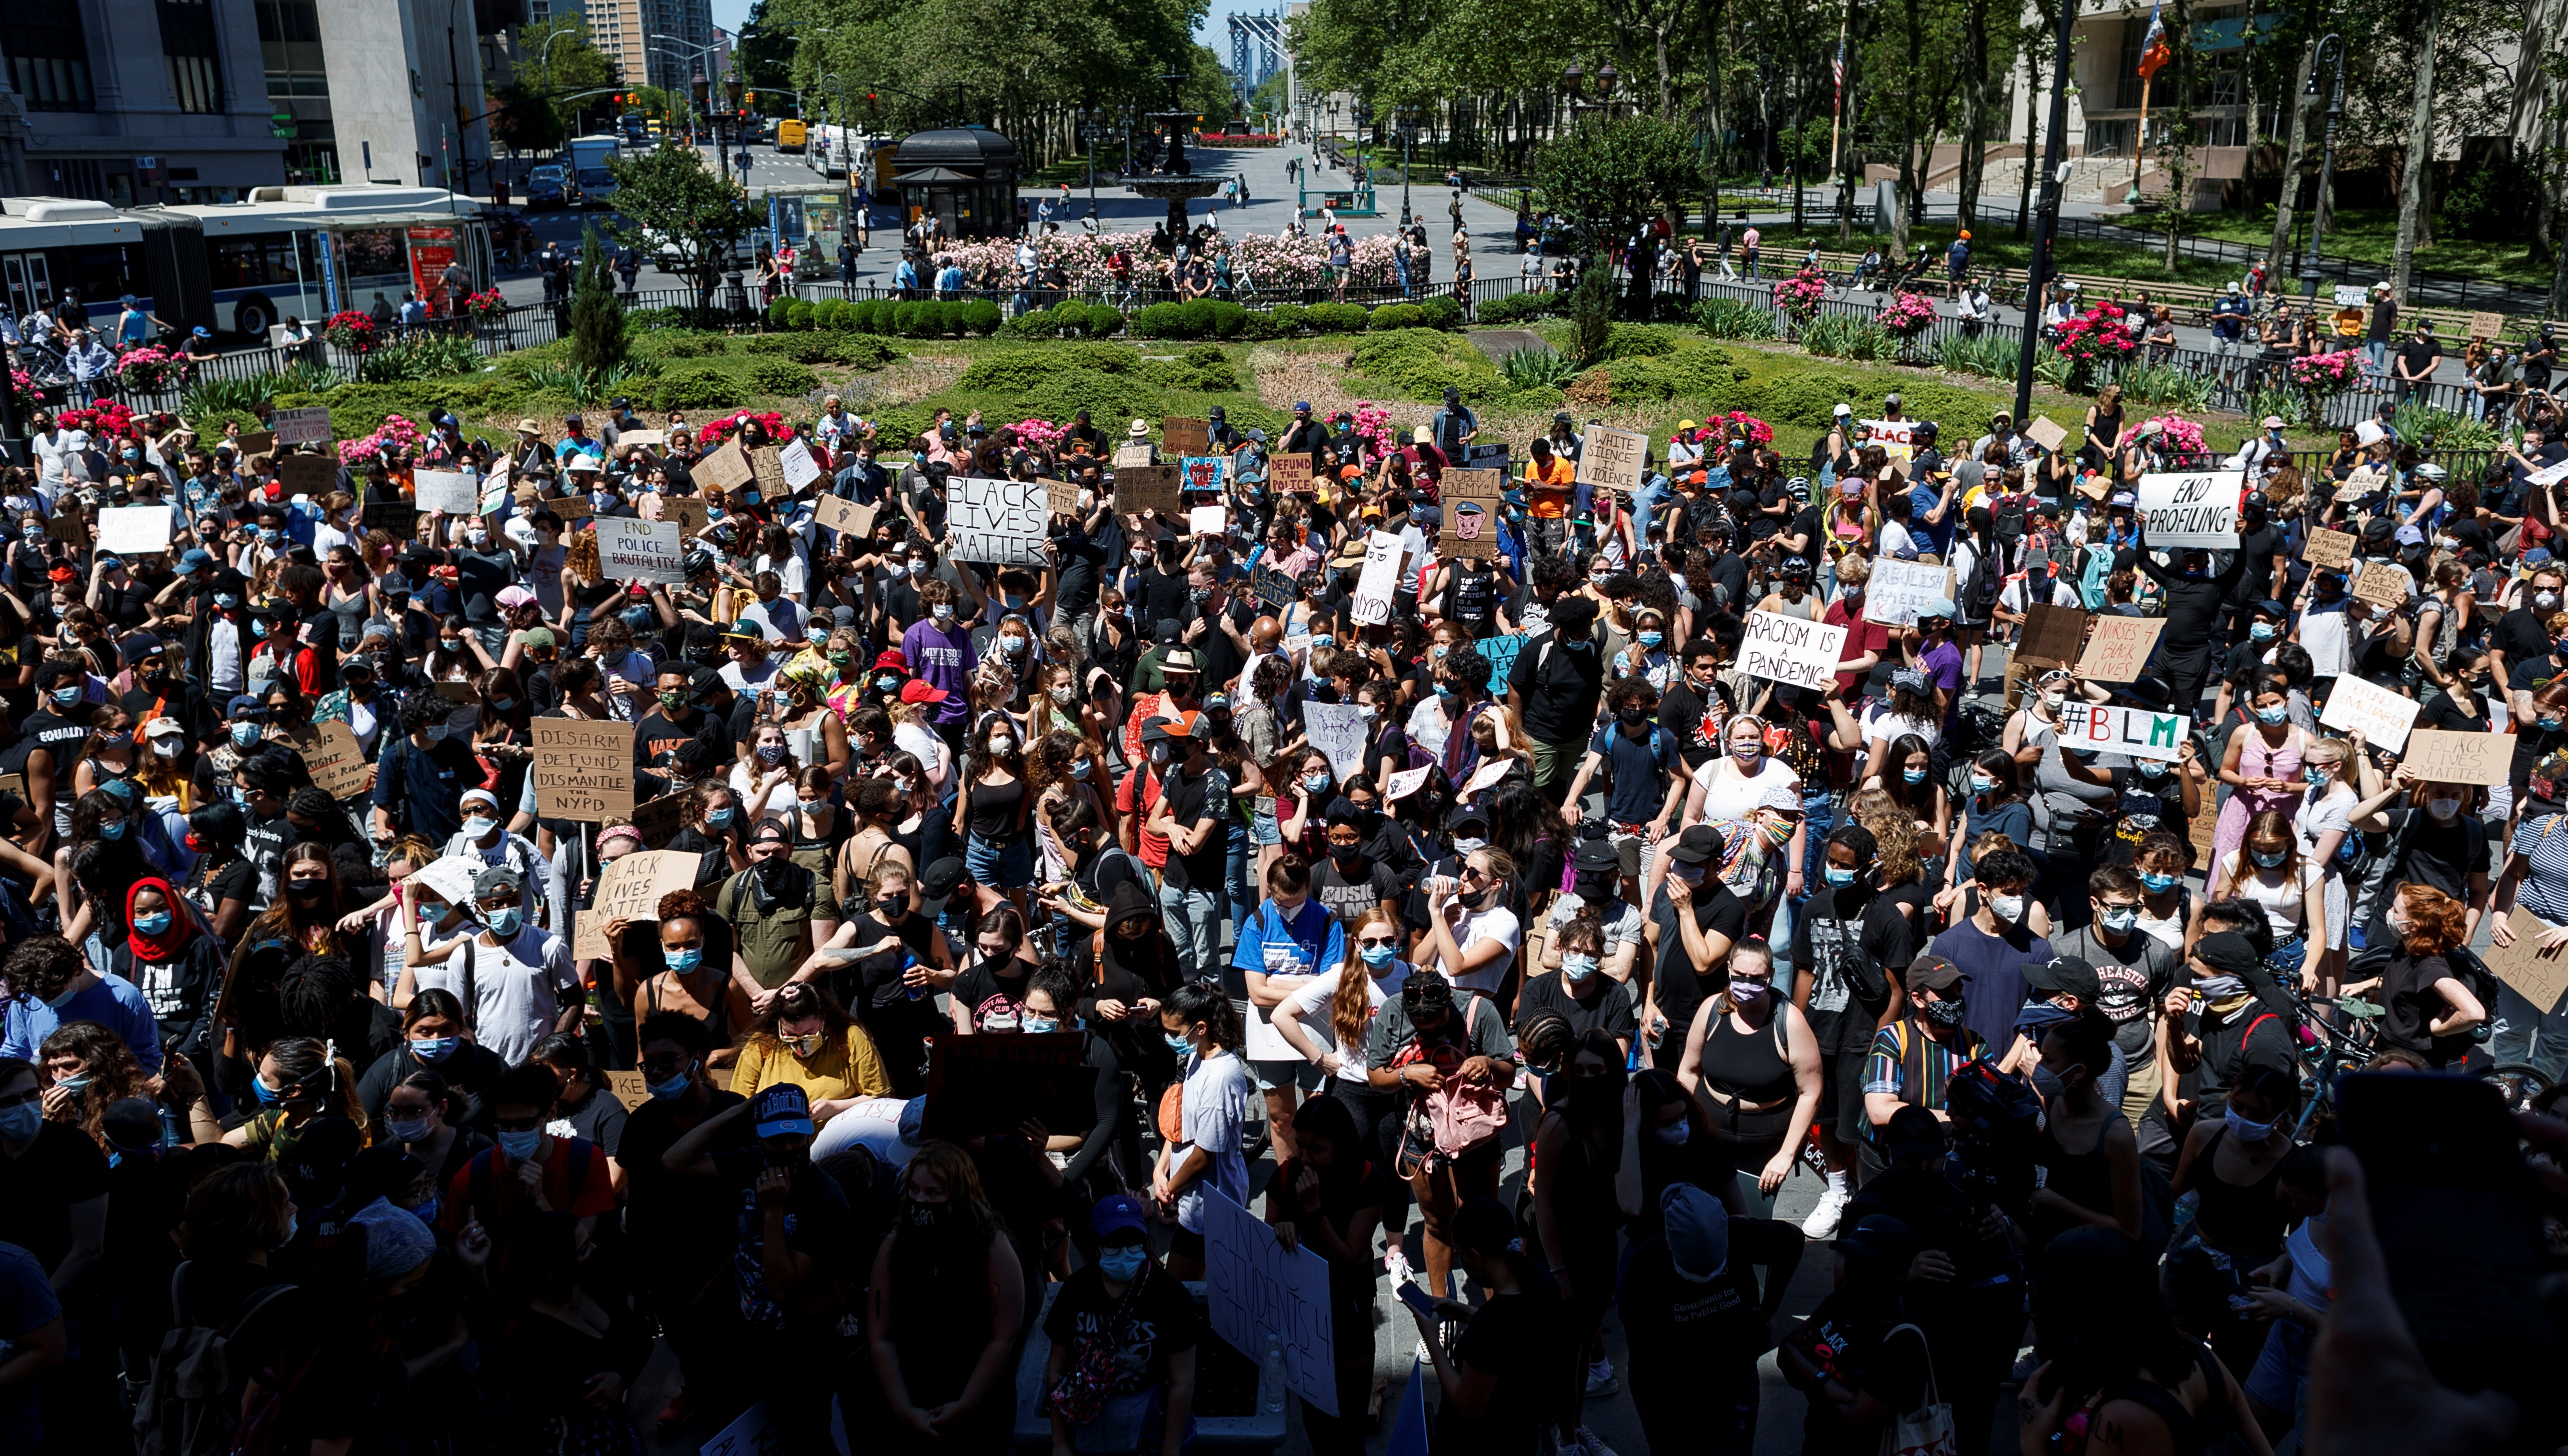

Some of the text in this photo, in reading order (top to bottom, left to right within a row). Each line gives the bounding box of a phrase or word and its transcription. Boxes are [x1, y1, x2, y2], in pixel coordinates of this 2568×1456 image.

[2476, 314, 2500, 323] BLACK
[2478, 321, 2498, 330] LIVES
[273, 409, 303, 421] POLICE
[1165, 420, 1207, 432] EDUCATION
[277, 427, 307, 443] KILLER
[1594, 431, 1636, 450] WHITE
[750, 446, 780, 467] BLACK
[1120, 447, 1150, 459] NO JUSTICE
[1479, 446, 1497, 456] NO
[1587, 444, 1632, 464] SILENCE
[698, 450, 736, 478] JUST STOP
[729, 460, 744, 474] US
[1184, 457, 1223, 468] NO BAD
[1271, 458, 1312, 471] DEFUND
[1474, 455, 1508, 468] JUSTICE
[1602, 459, 1616, 470] IS
[417, 474, 470, 488] PROTECT
[1136, 469, 1150, 478] NOT
[1184, 471, 1223, 484] APPLES!
[1279, 471, 1300, 479] THE
[1446, 469, 1486, 483] PUBLIC
[1585, 465, 1633, 487] VIOLENCE
[2351, 475, 2382, 486] BLACK
[418, 487, 449, 499] BLACK
[948, 477, 1041, 510] BLACK
[1060, 486, 1078, 497] LIVES
[1272, 479, 1311, 492] POLICE
[1444, 480, 1484, 496] ENEMY
[2172, 478, 2213, 503] END
[2348, 484, 2374, 492] LIVES
[573, 499, 587, 508] YOU
[1047, 492, 1074, 509] ATTER
[1120, 498, 1164, 509] ANTI-RACIST
[367, 507, 379, 516] No
[579, 508, 592, 516] YOU
[949, 503, 1041, 534] LIVES
[2148, 506, 2231, 533] PROFILING
[367, 517, 378, 526] No
[624, 521, 651, 536] END
[617, 537, 664, 554] POLICE
[1441, 541, 1494, 550] DEFUND NYPD
[2309, 536, 2350, 553] ES MI LUCHA
[2319, 530, 2351, 545] TU LUCHA
[948, 531, 1051, 567] MATTER
[1441, 548, 1474, 558] REPEAL
[612, 552, 676, 570] BRUTALITY
[1873, 565, 1945, 591] ABOLISH
[2362, 573, 2398, 589] LIVES
[2367, 563, 2410, 585] BLACK
[1255, 579, 1275, 599] LIVES
[2360, 582, 2397, 600] MATTER
[1353, 593, 1389, 621] NYPD
[1456, 612, 1484, 620] SYSTEM
[1746, 613, 1837, 653] RACISM IS
[2097, 620, 2157, 645] NURSES 4
[1780, 648, 1788, 658] A
[2100, 640, 2137, 661] BLACK
[1747, 651, 1825, 686] PANDEMIC
[2090, 661, 2132, 681] LIVES
[2345, 680, 2393, 707] DEFUND
[1311, 706, 1358, 721] BLACK
[1317, 718, 1357, 733] TRANS
[2065, 704, 2179, 748] #BLM
[39, 726, 91, 742] EQUALITY
[322, 733, 334, 746] IS
[541, 729, 621, 750] DISARM
[1317, 733, 1353, 744] LIVES
[2430, 732, 2489, 754] BLACK
[305, 751, 342, 770] RIGHT
[2426, 753, 2483, 768] LIVES
[327, 762, 367, 781] IS RIGHT
[2419, 764, 2488, 782] MATTER
[329, 778, 362, 795] MATTER
[539, 773, 624, 789] DISMANTLE
[556, 797, 605, 812] NYPD
[605, 855, 662, 888] BLACK
[445, 882, 466, 898] Floyd
[605, 878, 652, 903] LIVES
[1320, 884, 1376, 903] MUSIC
[594, 898, 662, 924] MATTER
[1344, 899, 1378, 917] MY
[2491, 952, 2559, 1006] MATTER
[980, 1000, 994, 1013] CUTE
[761, 1094, 807, 1121] CAROLINA
[299, 1164, 316, 1181] NY
[1235, 1210, 1300, 1292] NYC
[1211, 1240, 1331, 1366] STUDENTS 4
[1674, 1287, 1735, 1312] Consultants for
[1675, 1294, 1741, 1322] the Public Good
[1820, 1320, 1849, 1355] BLACK
